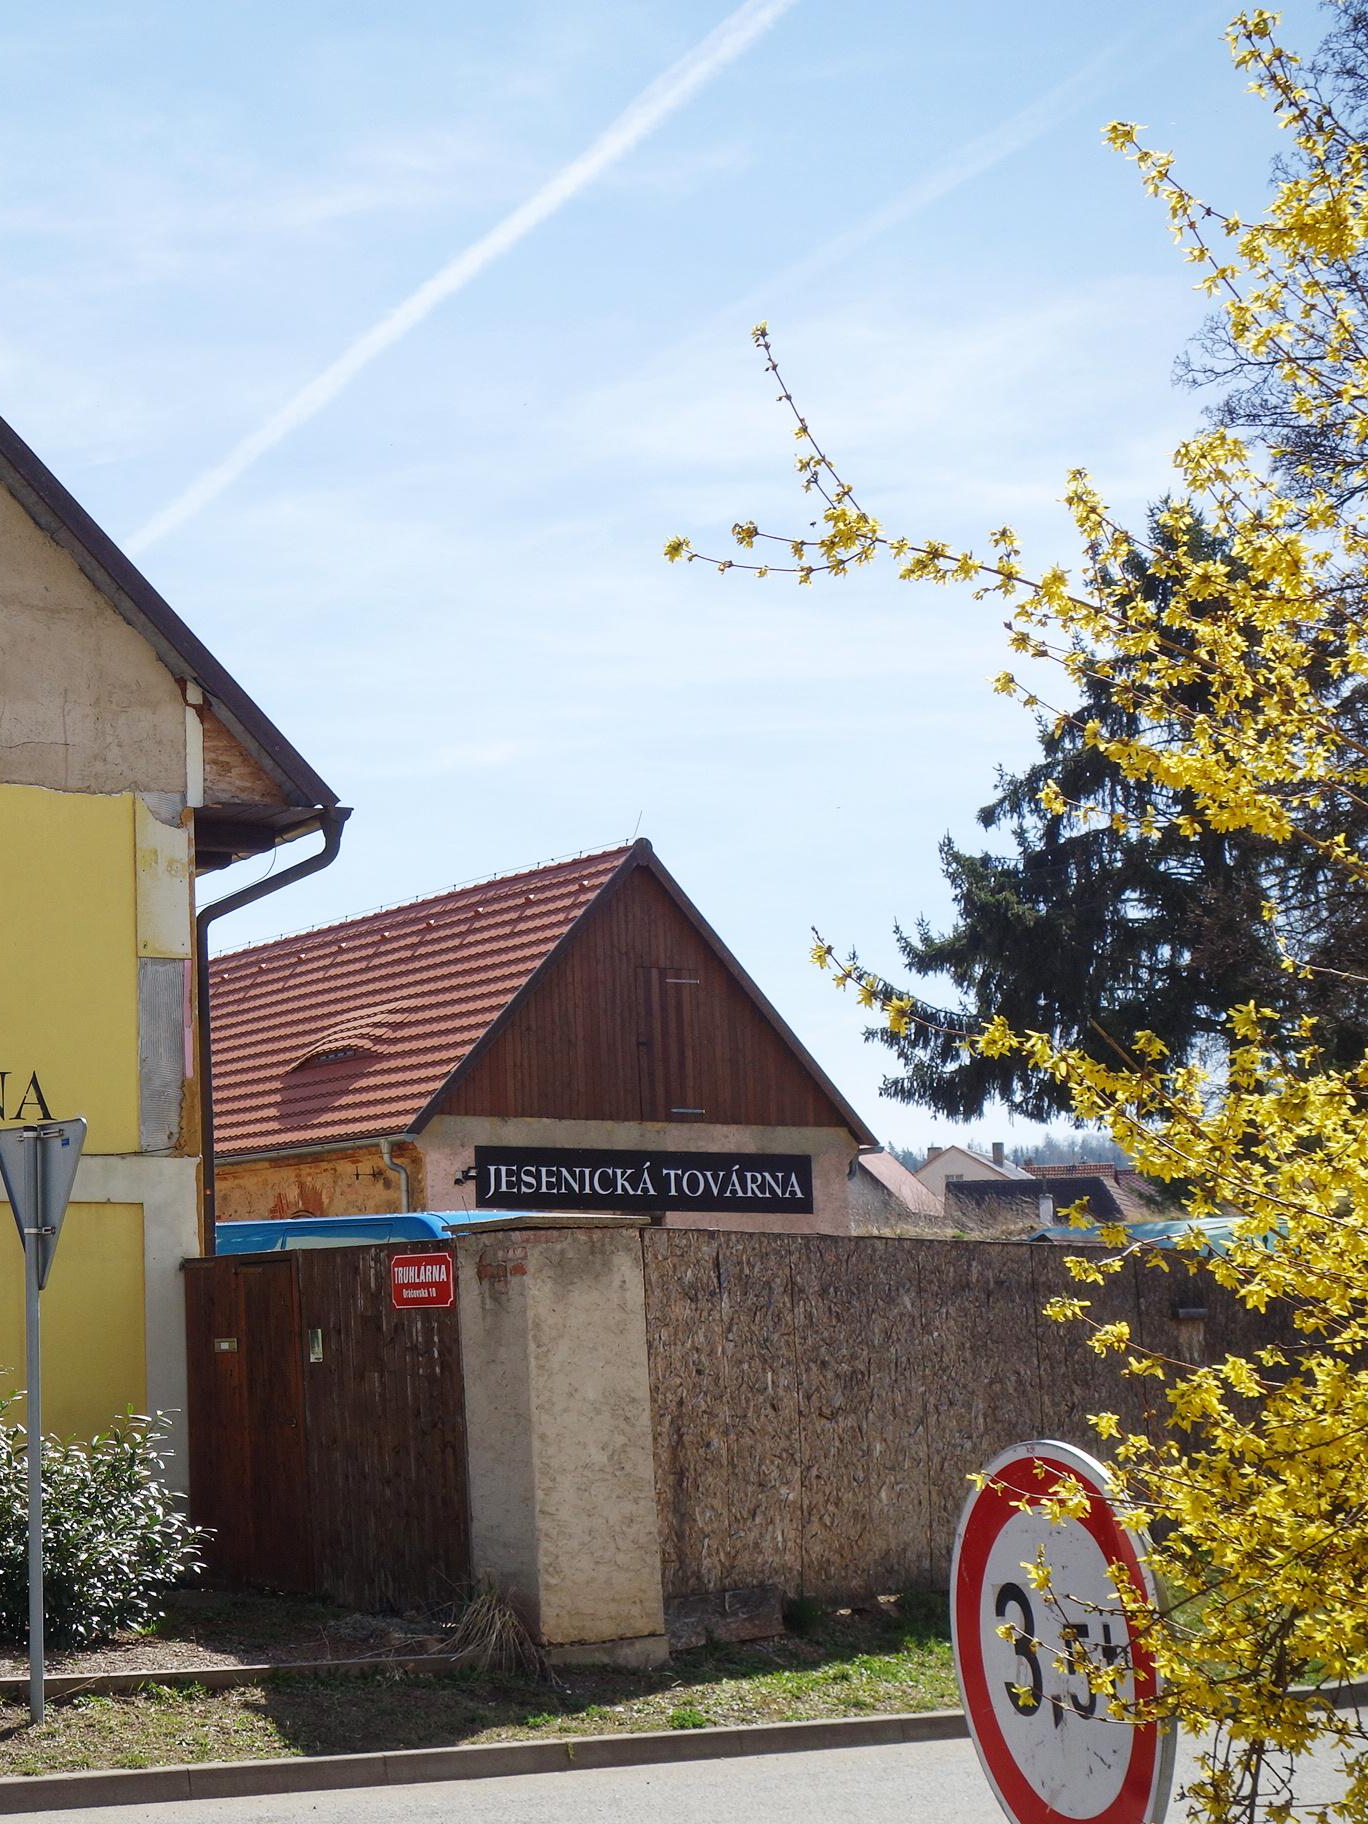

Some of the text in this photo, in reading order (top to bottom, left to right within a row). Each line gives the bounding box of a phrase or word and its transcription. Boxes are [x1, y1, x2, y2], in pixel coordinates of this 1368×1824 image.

[484, 1161, 806, 1199] JESENICKÁ TOVÁRNA
[394, 1261, 447, 1284] TRUHLÁRNA
